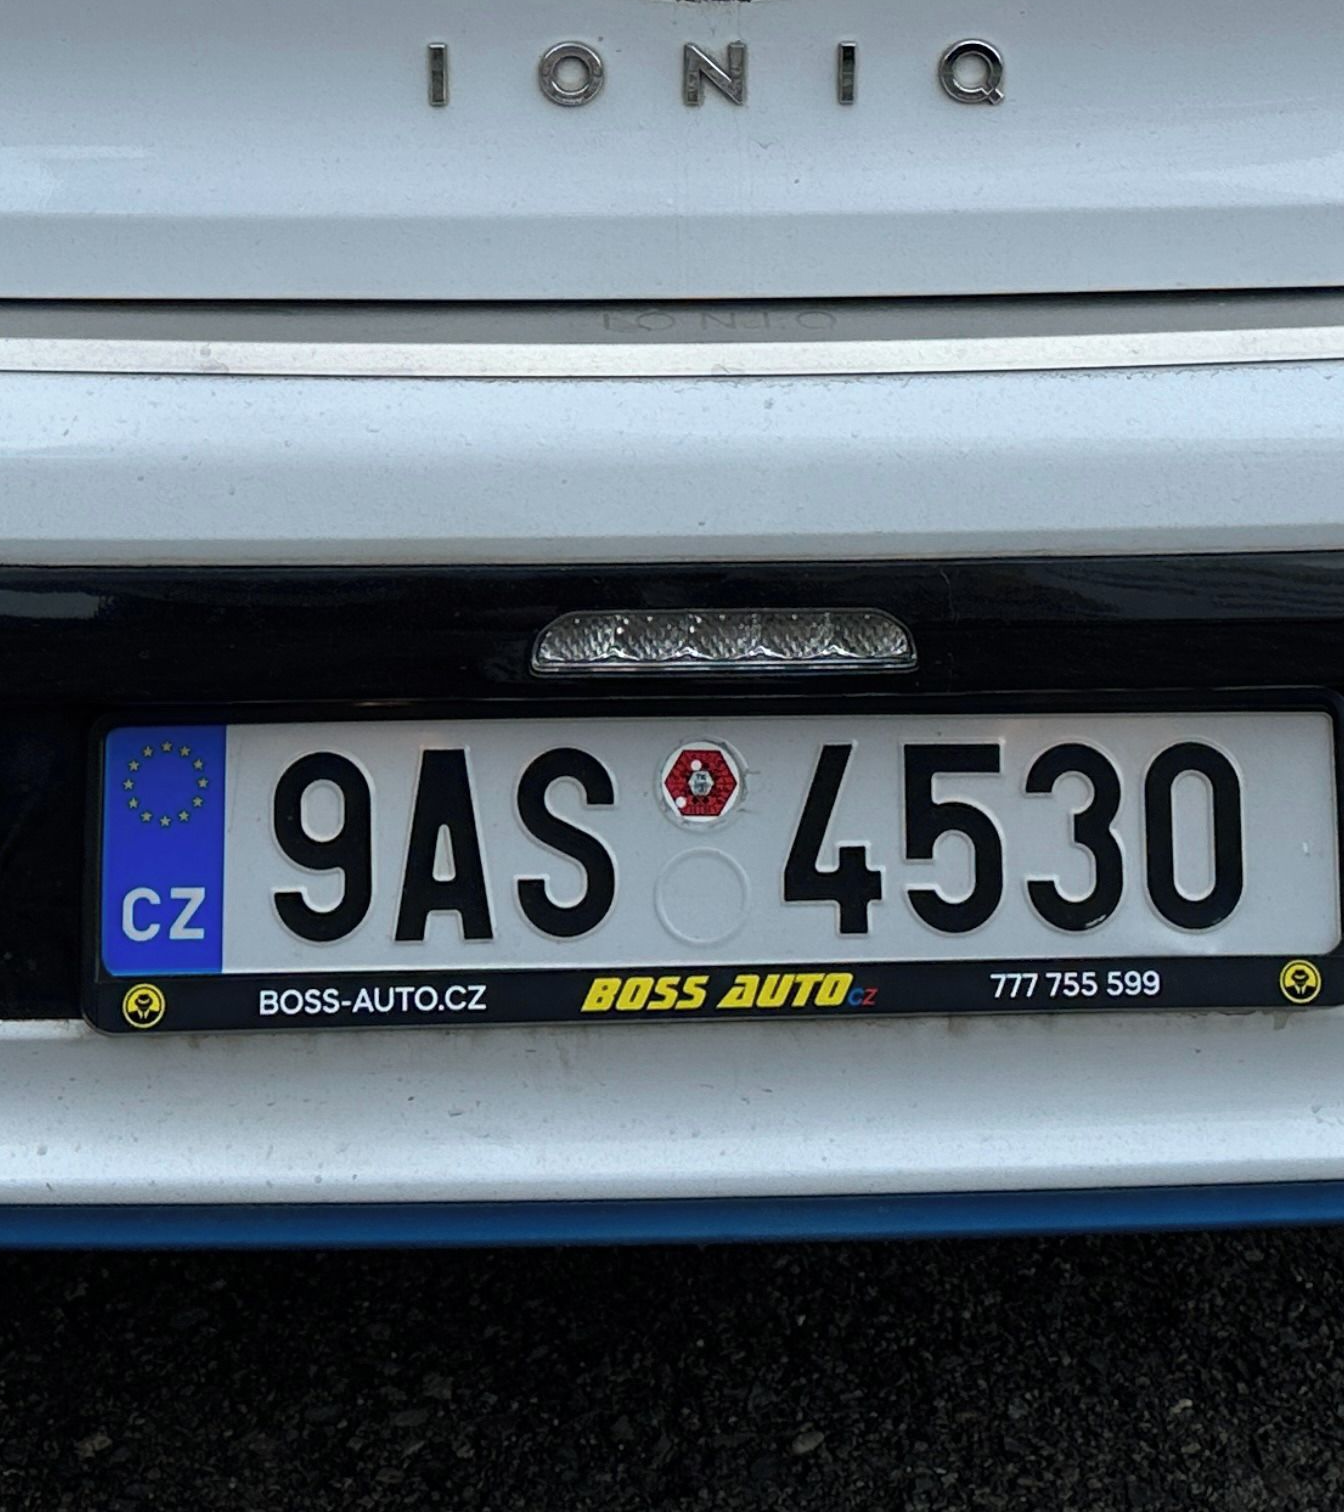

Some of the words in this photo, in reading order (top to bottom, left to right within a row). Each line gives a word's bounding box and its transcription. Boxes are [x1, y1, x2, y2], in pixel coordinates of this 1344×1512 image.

[428, 38, 1005, 107] IONIQ
[273, 747, 616, 943] 9AS
[783, 741, 1245, 935] 4530
[122, 887, 205, 941] CZ
[259, 985, 487, 1015] BOSS-AUTO.CZ
[580, 975, 709, 1012] BOSS
[990, 973, 1039, 998] 777
[1046, 972, 1096, 996] 755
[1106, 970, 1160, 996] 599
